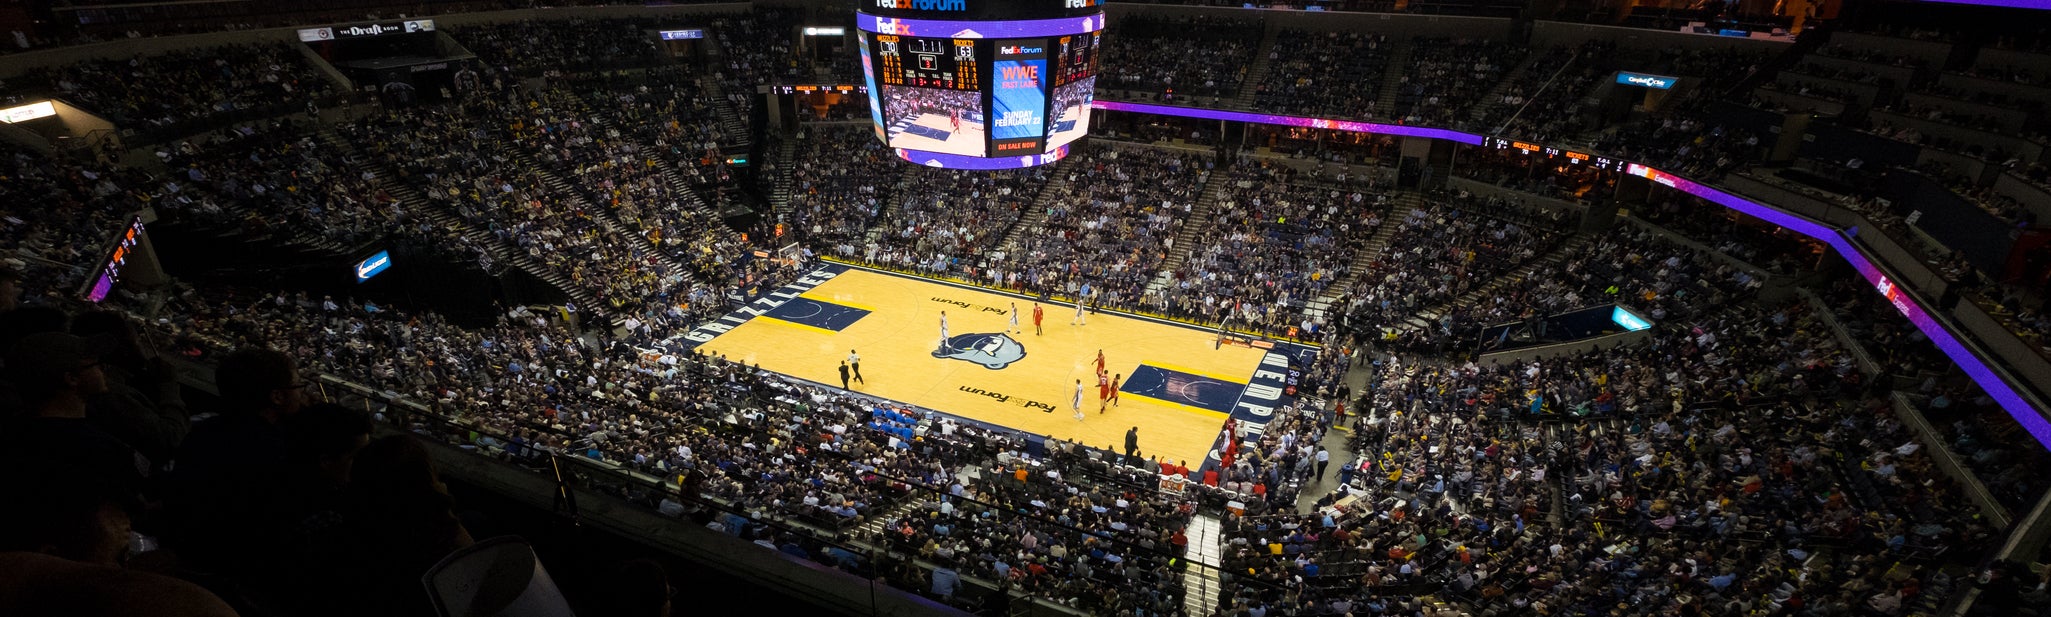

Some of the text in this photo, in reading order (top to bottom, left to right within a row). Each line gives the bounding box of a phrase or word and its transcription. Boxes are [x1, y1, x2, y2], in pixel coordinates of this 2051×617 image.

[350, 24, 383, 35] Draft
[876, 17, 910, 36] FedEx
[919, 40, 941, 52] 7:11
[961, 46, 971, 56] 63
[1001, 46, 1042, 54] FedExForum
[1002, 65, 1038, 80] WWE
[948, 80, 953, 88] 2
[995, 116, 1041, 126] FEBRUARY 22
[1003, 111, 1033, 120] SUNDAY
[1566, 151, 1589, 160] ROCKETS
[1877, 275, 1897, 302] FedEx
[685, 270, 837, 342] GRIZZLIES
[931, 297, 1008, 316] FedExForum
[959, 385, 1056, 413] FedExForum
